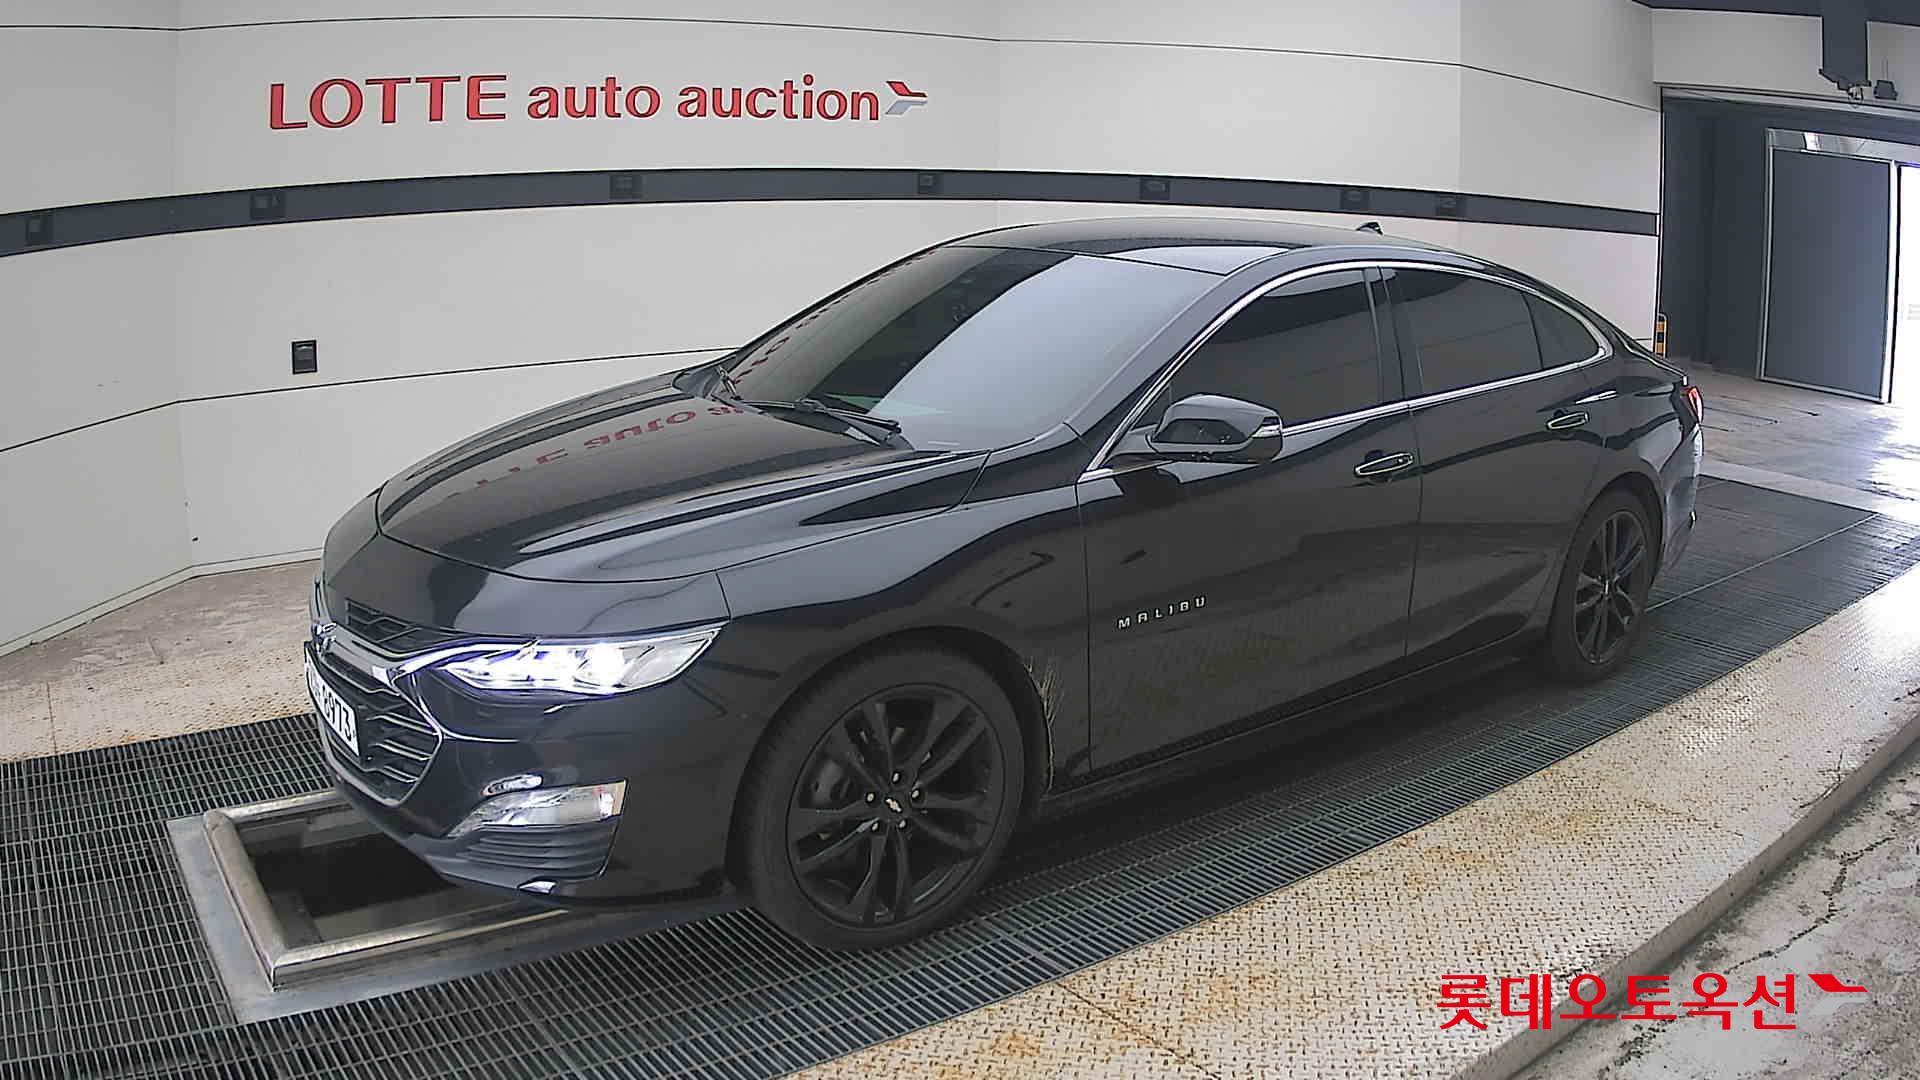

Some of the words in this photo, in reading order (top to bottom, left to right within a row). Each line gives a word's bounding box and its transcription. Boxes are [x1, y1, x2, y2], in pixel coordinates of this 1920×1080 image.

[269, 74, 507, 130] LOTTE
[526, 76, 662, 120] auto
[676, 74, 881, 121] auction
[1117, 596, 1207, 630] MALIBU
